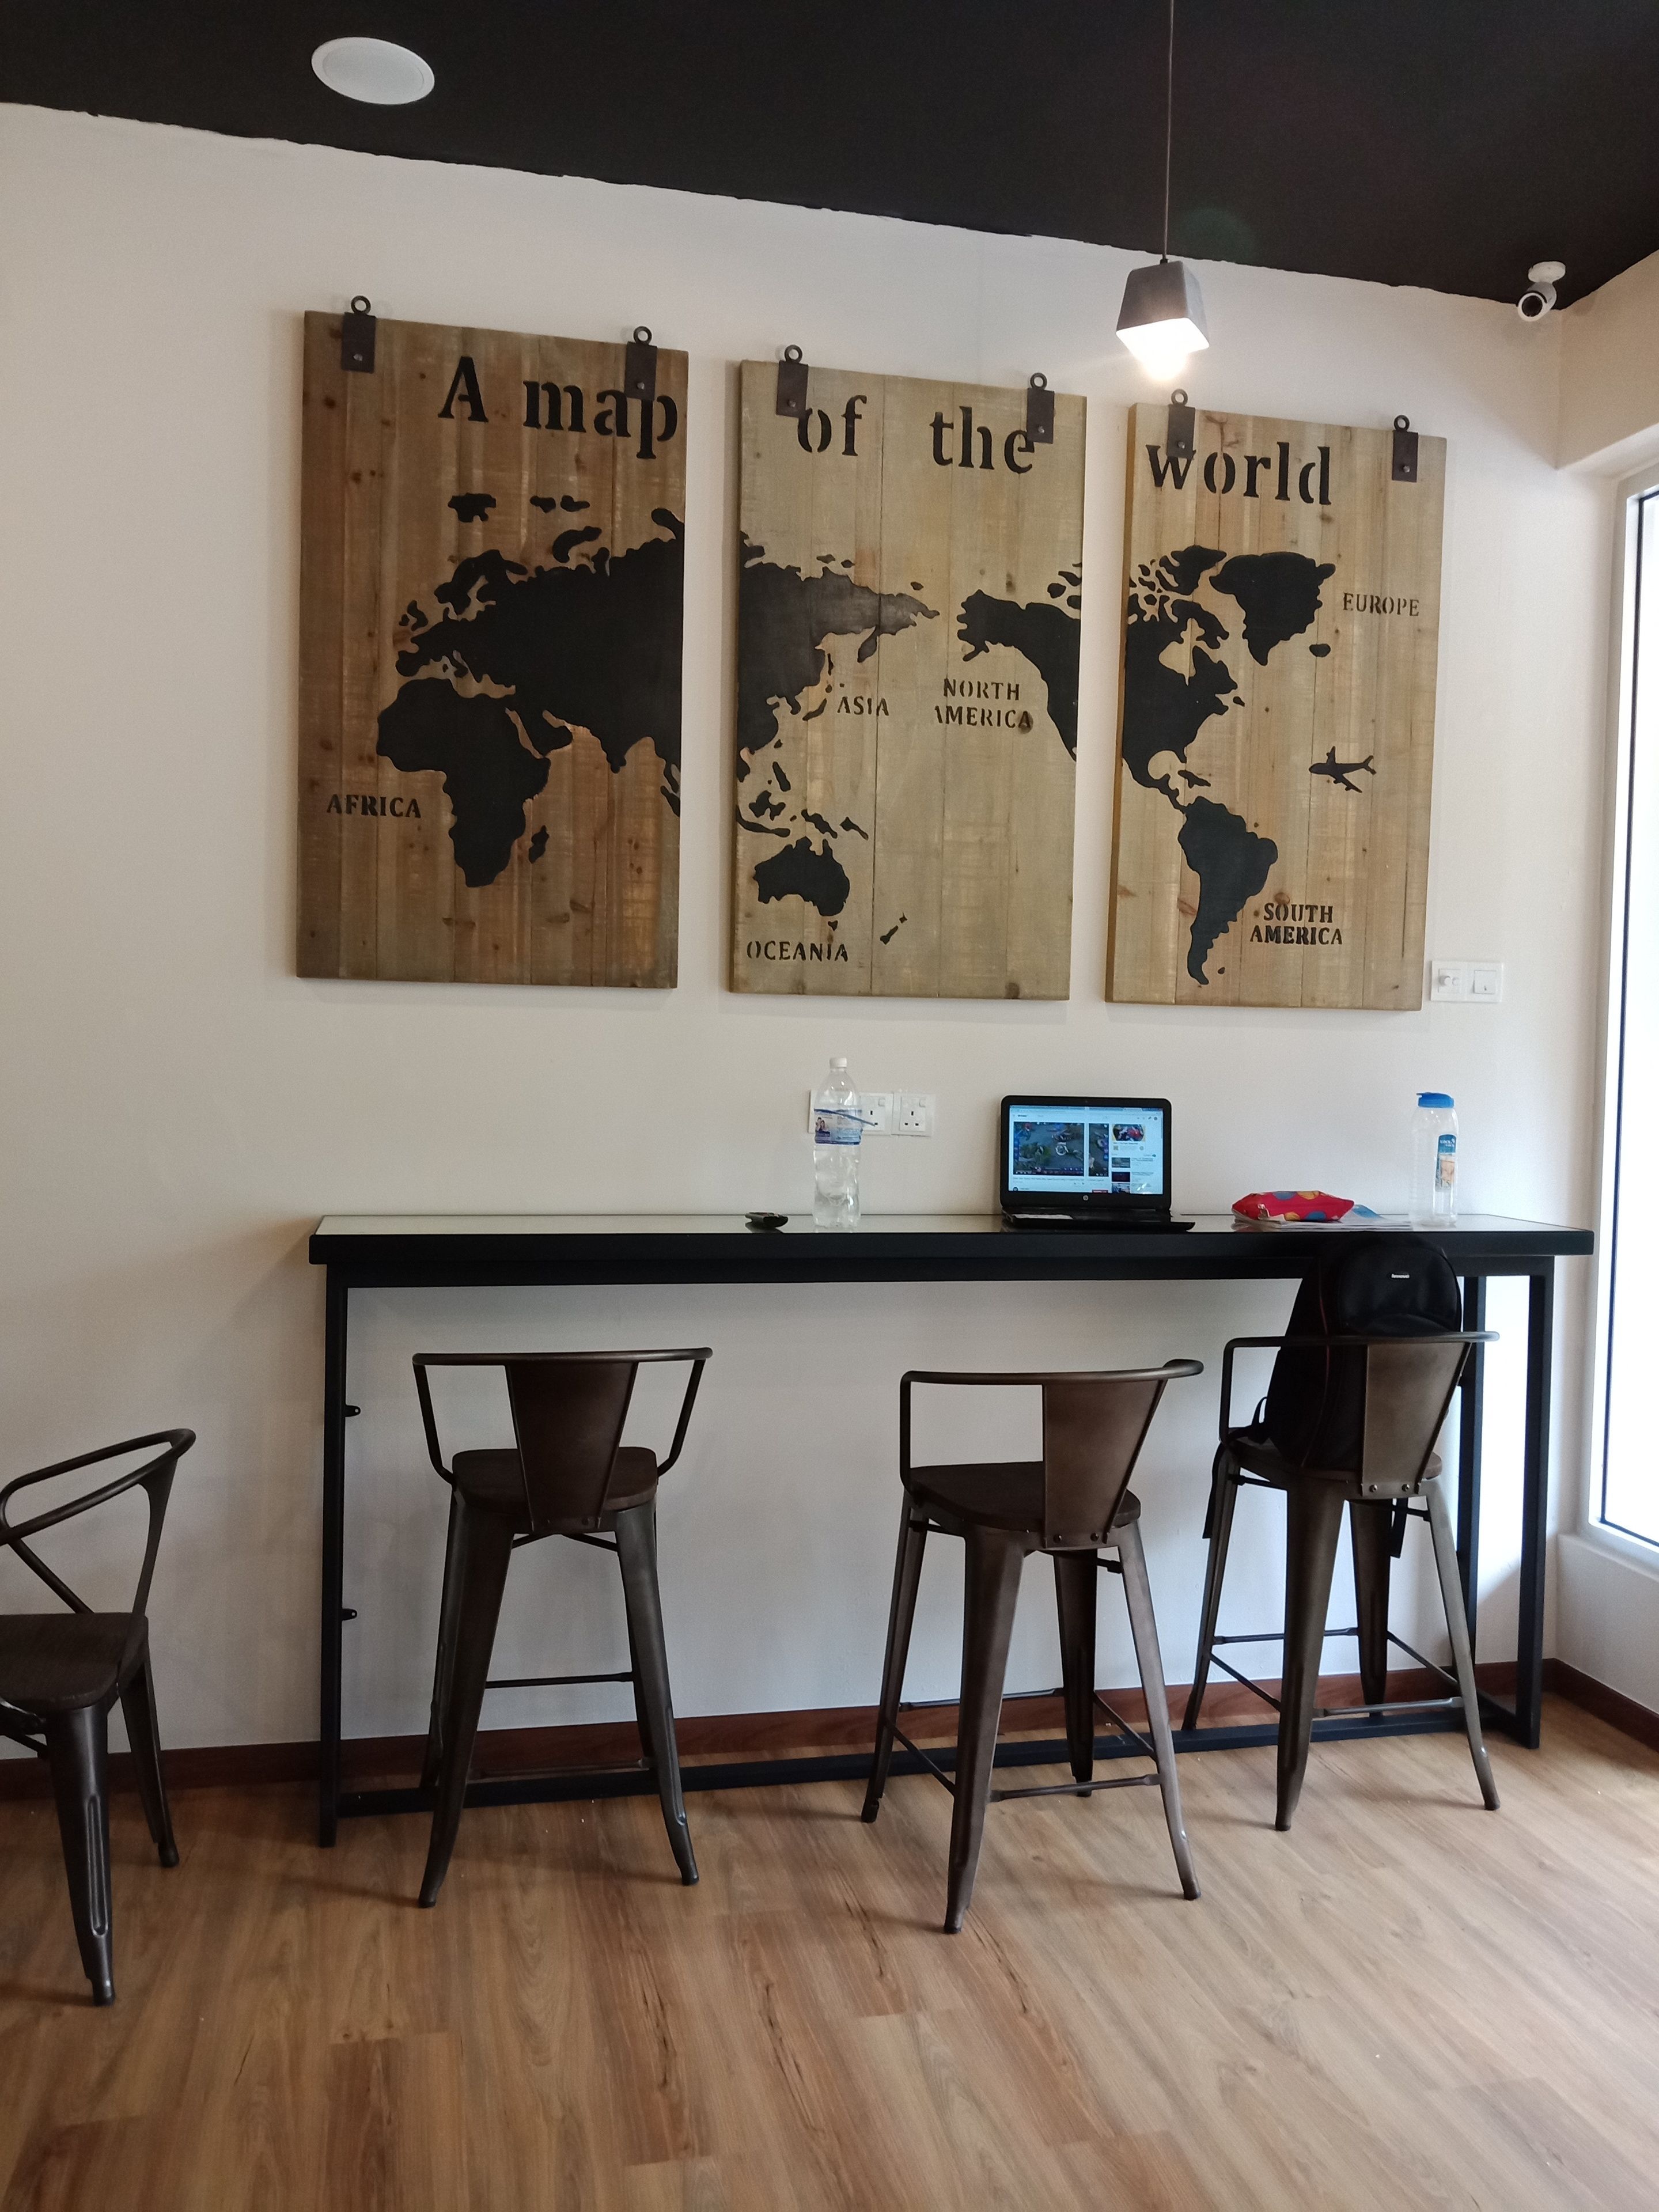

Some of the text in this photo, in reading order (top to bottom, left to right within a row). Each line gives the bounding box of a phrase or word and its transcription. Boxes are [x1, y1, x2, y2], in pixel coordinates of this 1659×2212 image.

[437, 356, 678, 460] A map
[797, 394, 1035, 474] of the
[1145, 441, 1332, 506] world
[1342, 592, 1420, 617] EUROPE
[943, 677, 1020, 701] NORTH
[837, 695, 889, 717] ASIA
[934, 704, 1031, 729] AMERICA
[326, 793, 422, 819] AFRICA
[1263, 902, 1334, 923] SOUTH
[1249, 925, 1343, 945] AMERICA
[746, 940, 849, 963] OCEANIA
